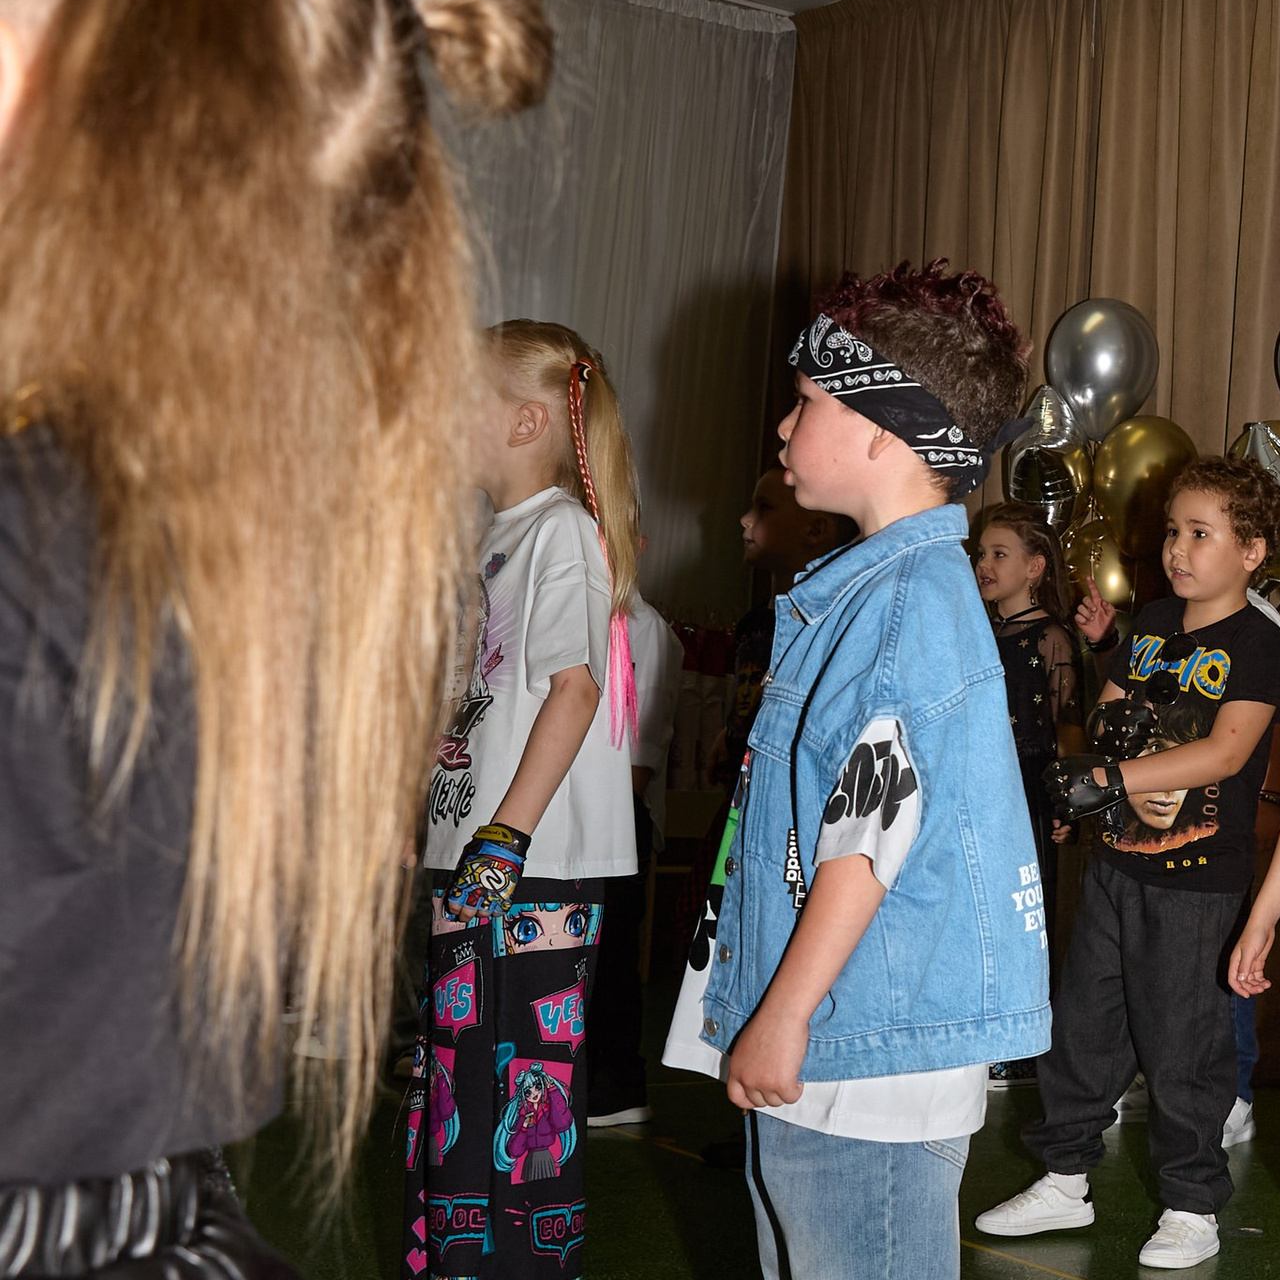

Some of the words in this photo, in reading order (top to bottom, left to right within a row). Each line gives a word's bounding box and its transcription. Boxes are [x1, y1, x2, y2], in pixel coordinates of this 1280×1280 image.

[1018, 861, 1039, 887] BE
[435, 976, 473, 1021] YES
[539, 1212, 585, 1240] COO
